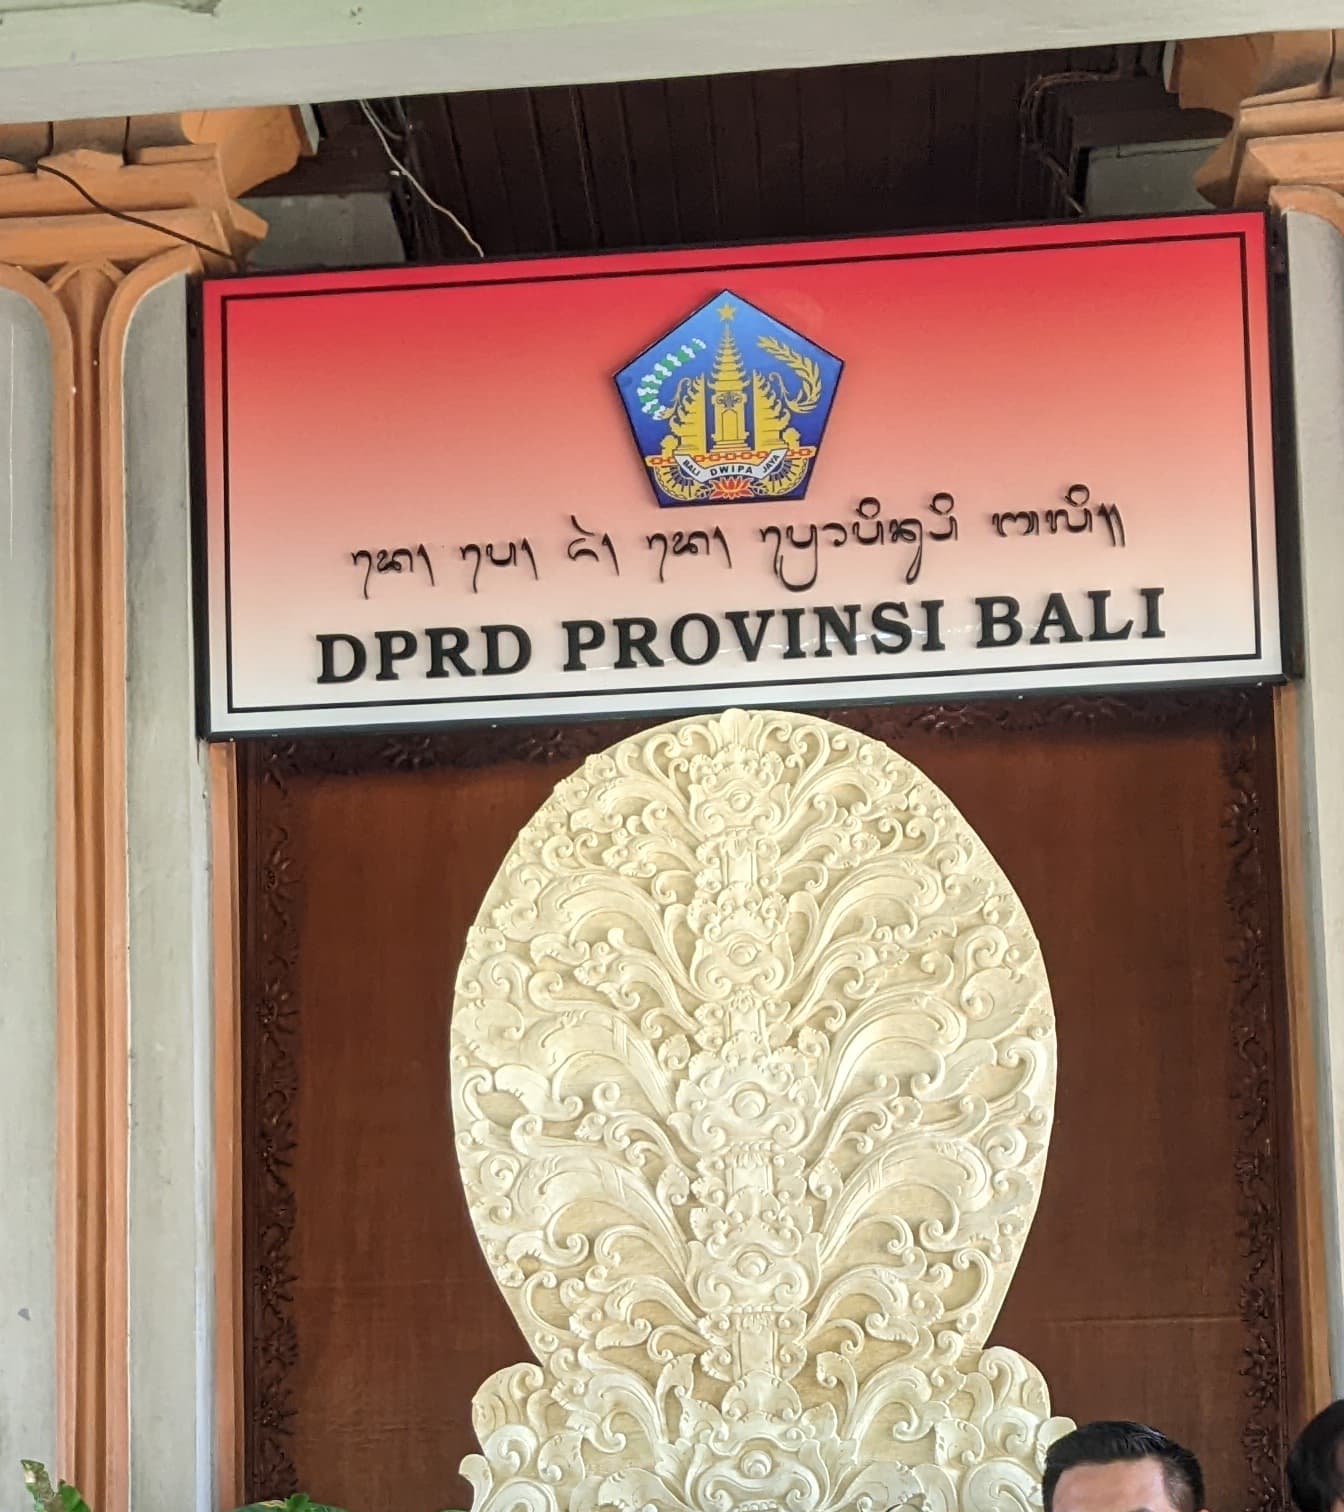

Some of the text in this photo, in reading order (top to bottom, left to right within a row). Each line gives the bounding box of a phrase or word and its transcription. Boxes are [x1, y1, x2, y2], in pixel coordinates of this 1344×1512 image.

[682, 454, 780, 477] BALI DWIPA JAYA
[316, 587, 1166, 685] DPRD PROVINSI BALI
